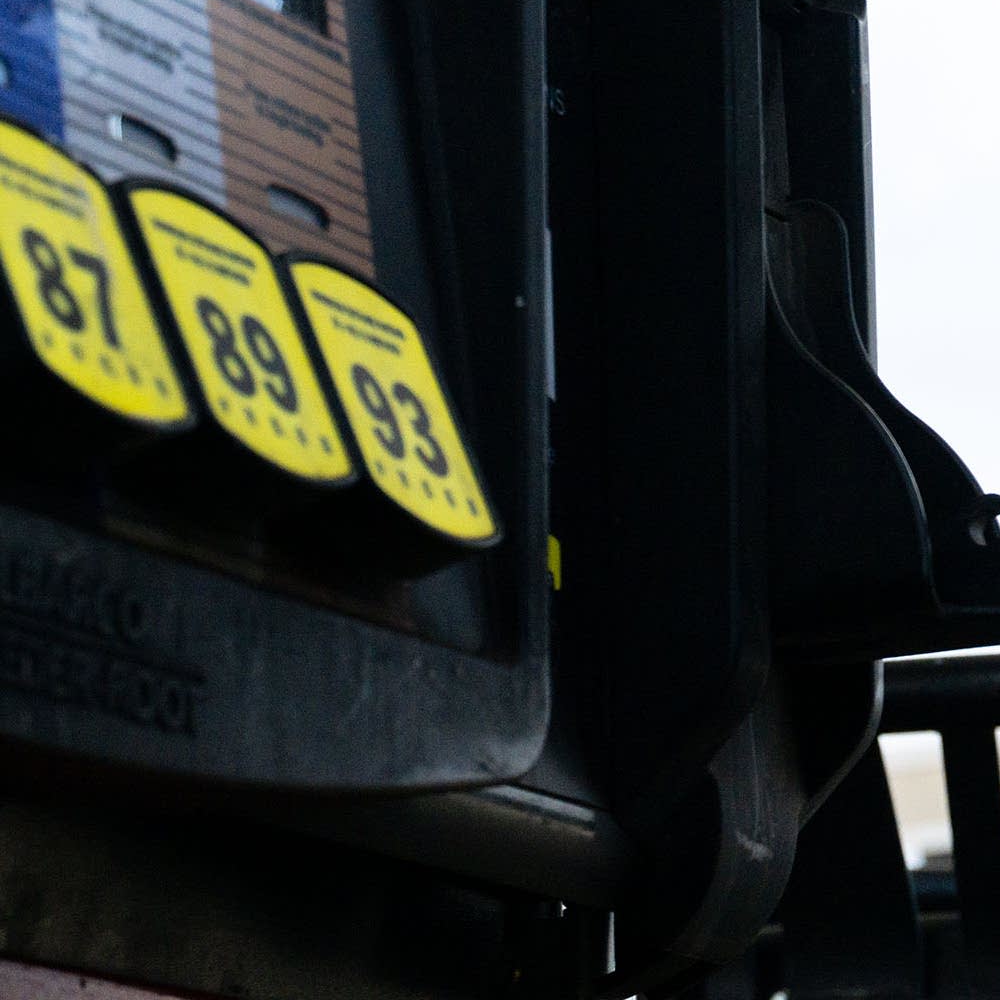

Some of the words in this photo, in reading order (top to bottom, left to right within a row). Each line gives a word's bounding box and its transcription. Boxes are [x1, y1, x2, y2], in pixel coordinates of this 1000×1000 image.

[21, 228, 122, 350] 87
[195, 297, 298, 415] 89
[351, 363, 449, 480] 93
